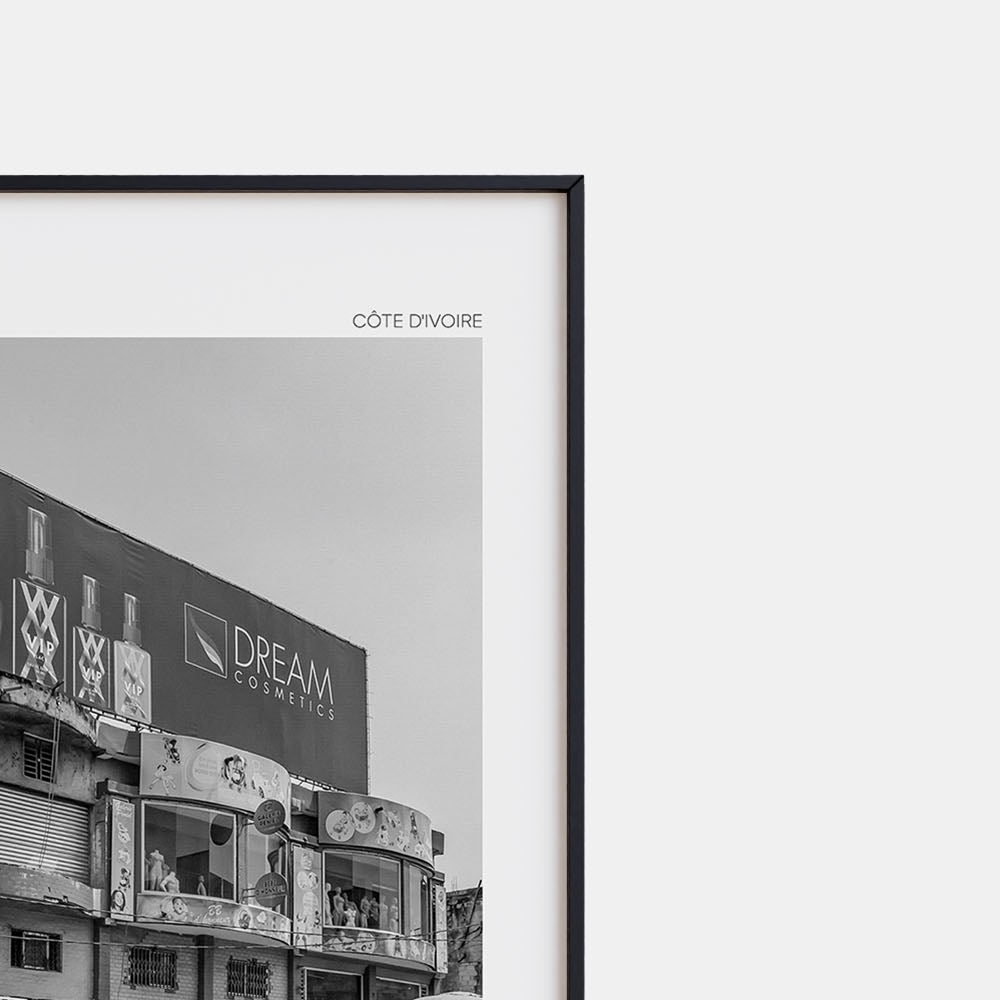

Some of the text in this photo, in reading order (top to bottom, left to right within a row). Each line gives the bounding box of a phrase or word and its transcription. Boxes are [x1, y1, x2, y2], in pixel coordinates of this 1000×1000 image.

[352, 309, 483, 329] CÔTE D'IVOIRE
[26, 632, 55, 655] VIP
[83, 664, 102, 681] VIP
[235, 625, 333, 705] DREAM
[124, 680, 143, 696] VIP
[234, 670, 335, 721] COSMETICS
